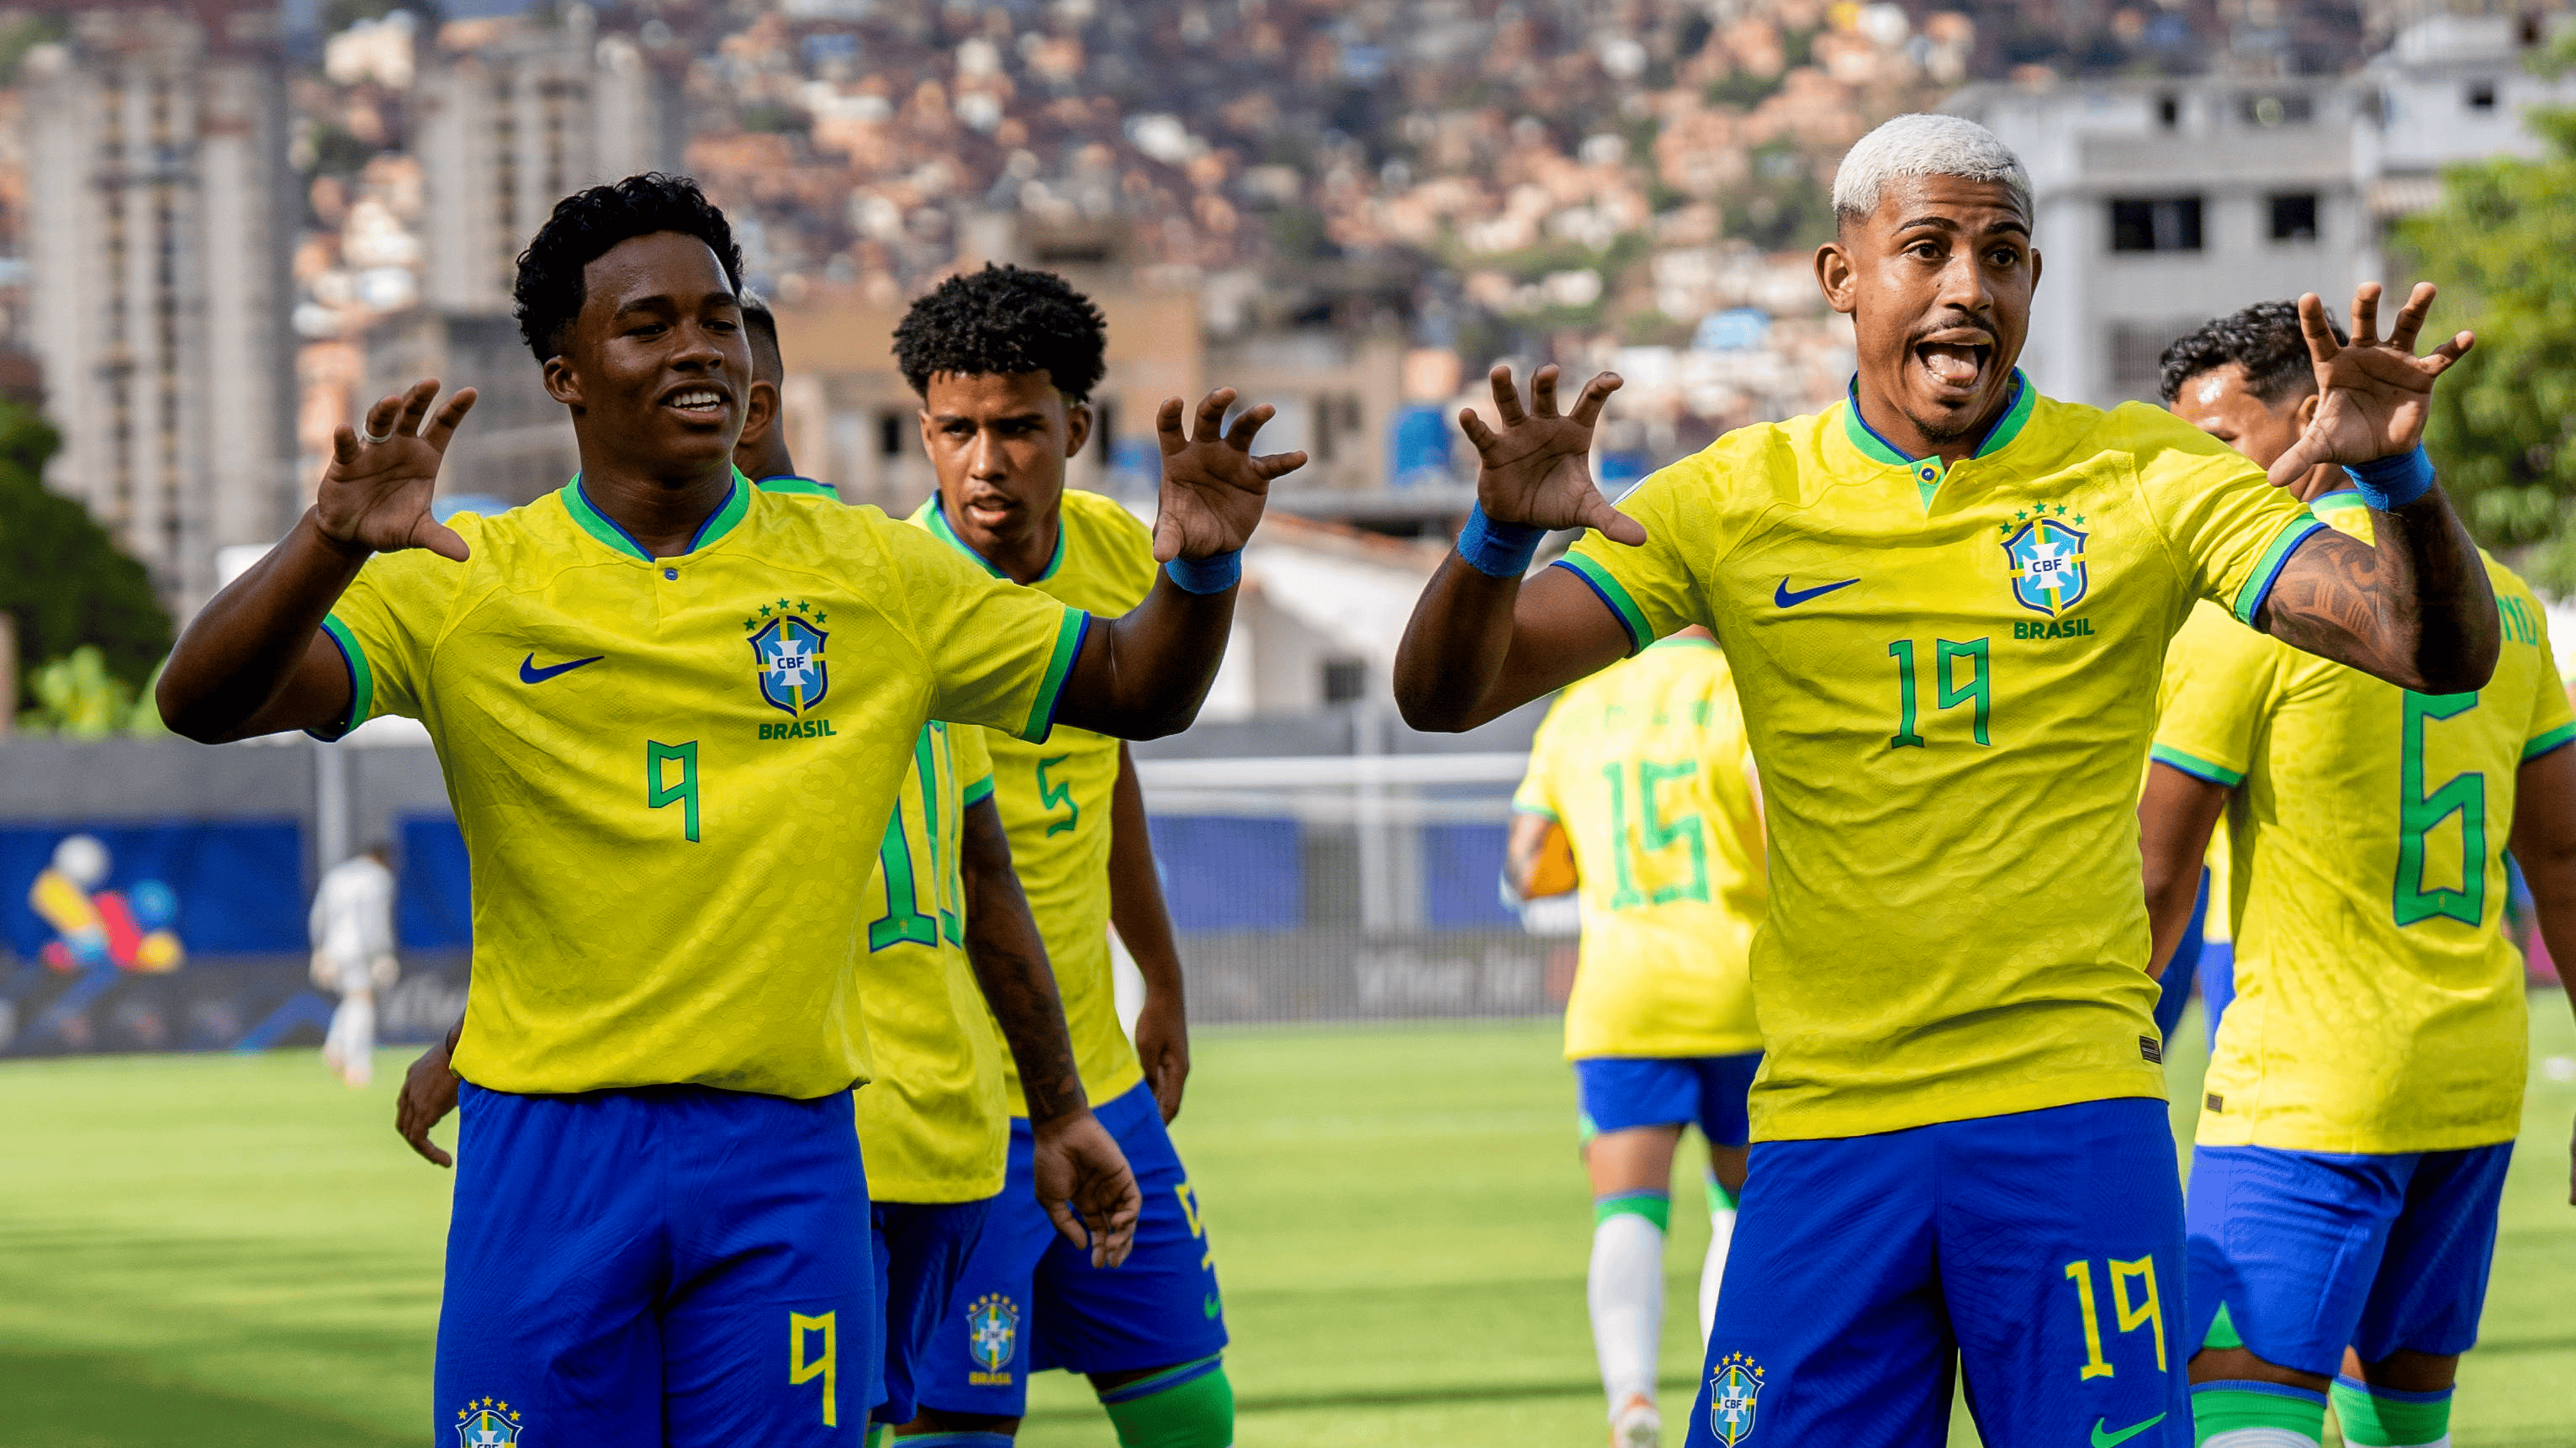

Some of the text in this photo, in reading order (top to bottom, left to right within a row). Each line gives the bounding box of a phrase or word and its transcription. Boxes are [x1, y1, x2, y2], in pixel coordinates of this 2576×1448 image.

[2032, 558, 2062, 573] CBF
[777, 656, 805, 669] CBF
[2014, 618, 2096, 640] BRASIL
[759, 719, 837, 740] BRASIL
[1889, 637, 1991, 748] 19
[648, 739, 700, 843] 9
[1036, 753, 1079, 838] 5
[1601, 758, 1712, 911] 15
[2393, 688, 2486, 928] 6
[2065, 1254, 2168, 1382] 19
[789, 1309, 837, 1428] 9
[1724, 1399, 1743, 1409] CBF
